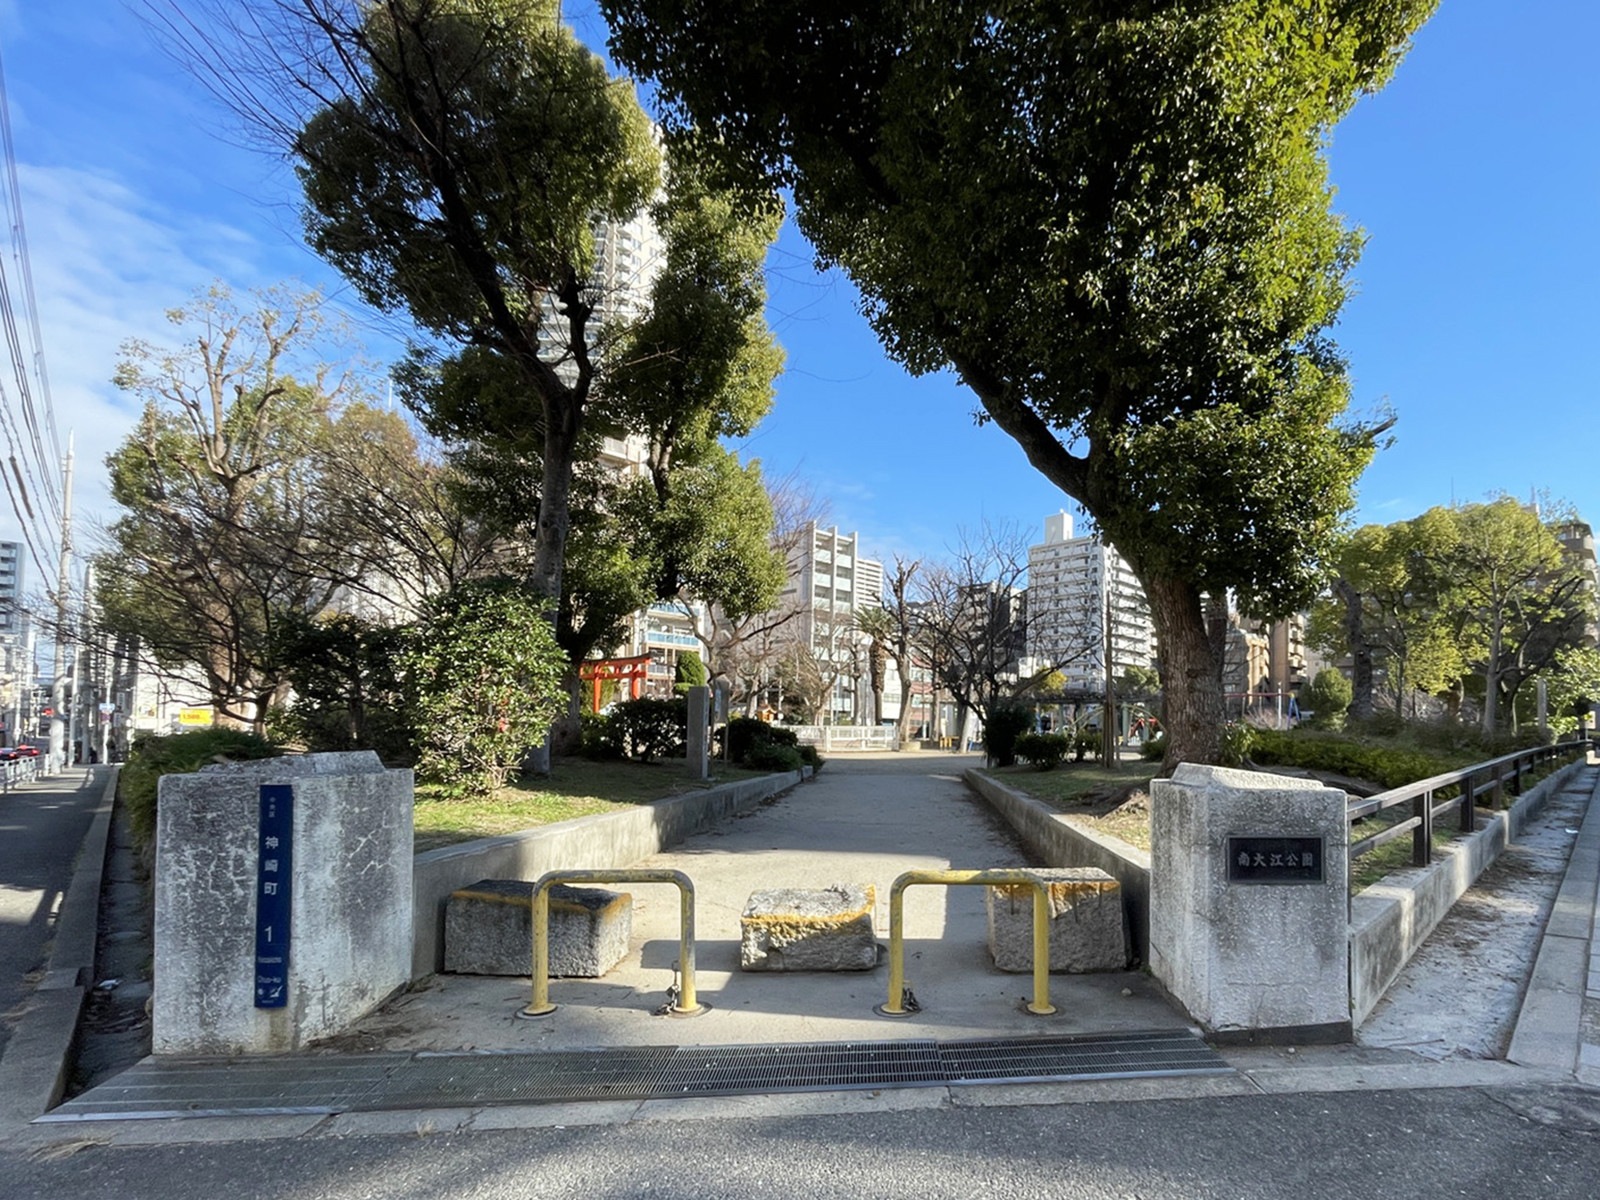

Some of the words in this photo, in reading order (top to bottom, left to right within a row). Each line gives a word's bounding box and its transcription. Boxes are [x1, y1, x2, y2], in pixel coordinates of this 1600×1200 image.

[1237, 851, 1314, 868] 南大江公園
[264, 925, 272, 943] 1
